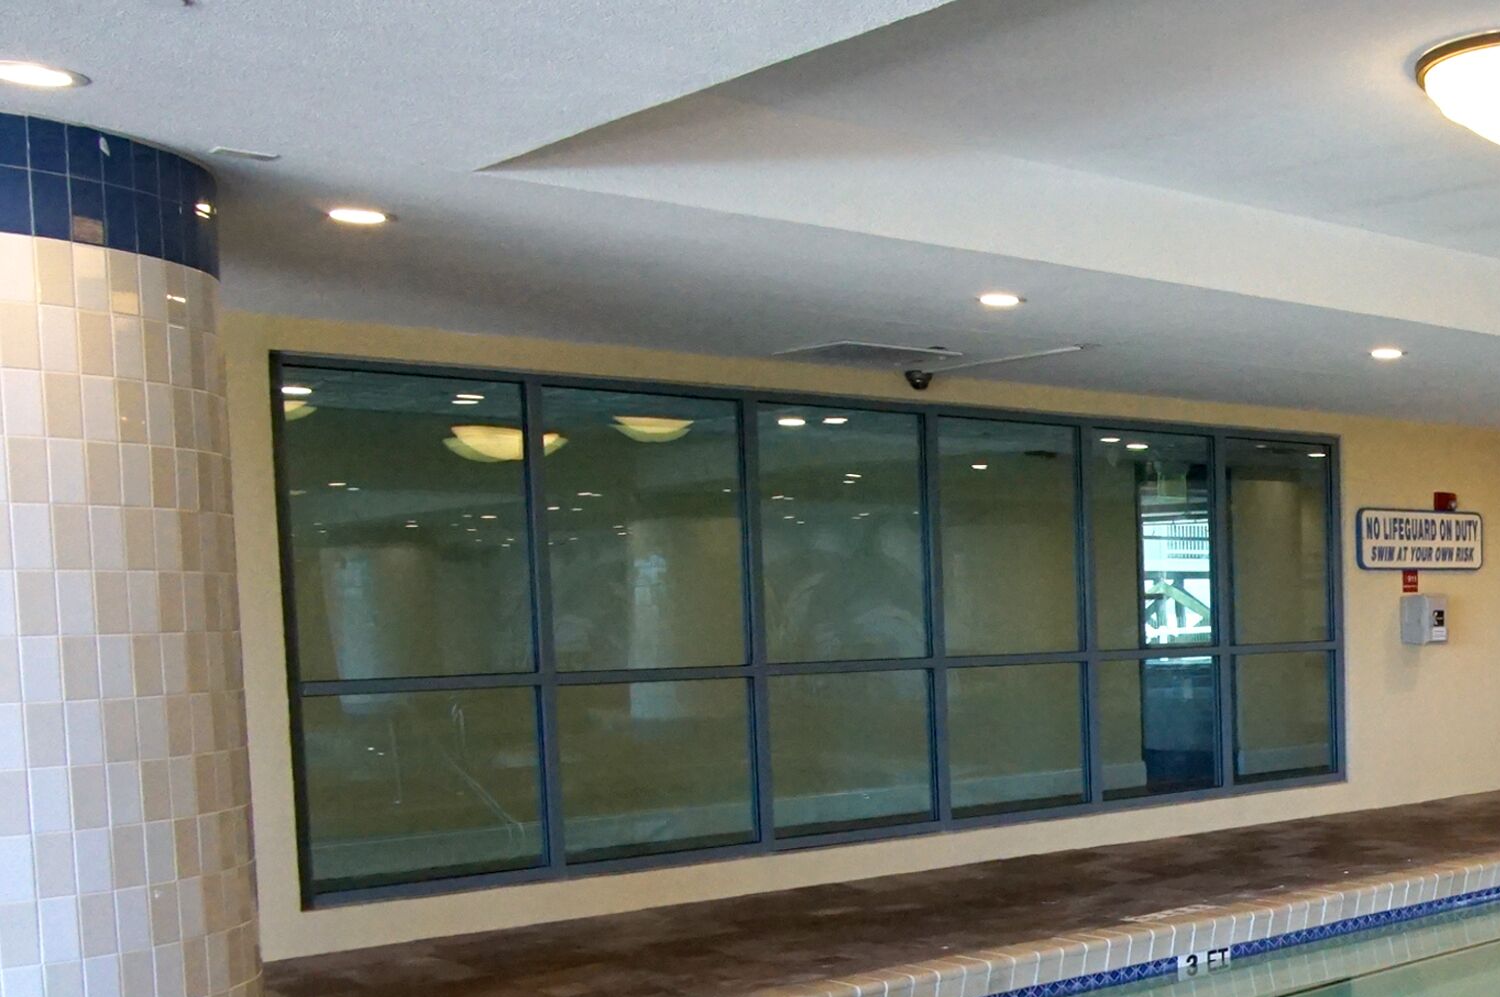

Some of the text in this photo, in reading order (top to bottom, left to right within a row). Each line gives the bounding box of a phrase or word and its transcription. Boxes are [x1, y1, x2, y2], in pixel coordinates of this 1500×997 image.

[1366, 517, 1478, 542] NO LIFEGUARD ON DUTY
[1371, 546, 1475, 562] SWIM AT YOUR OWN RISK
[1186, 954, 1198, 973] 3
